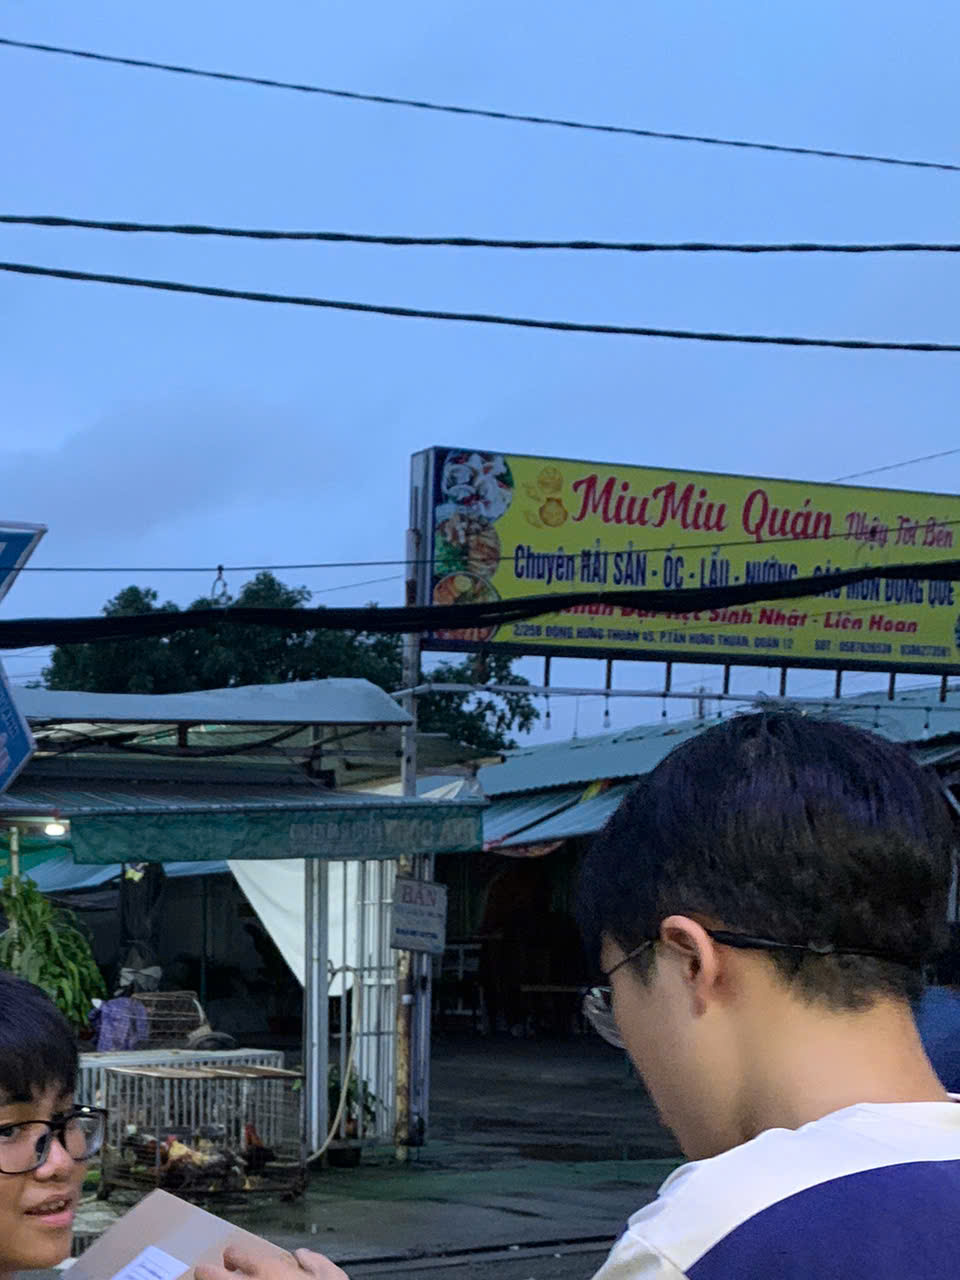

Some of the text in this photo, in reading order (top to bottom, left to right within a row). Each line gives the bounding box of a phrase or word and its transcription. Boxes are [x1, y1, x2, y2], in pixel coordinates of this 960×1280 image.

[743, 489, 833, 543] Quán
[515, 544, 575, 585] Chuyên
[580, 538, 608, 584] HẢI
[614, 540, 646, 586] SẢN
[664, 544, 685, 589] ỐC
[709, 607, 752, 625] Sinh
[758, 608, 808, 631] Nhật
[824, 612, 863, 630] Liên
[869, 615, 918, 632] Hoan
